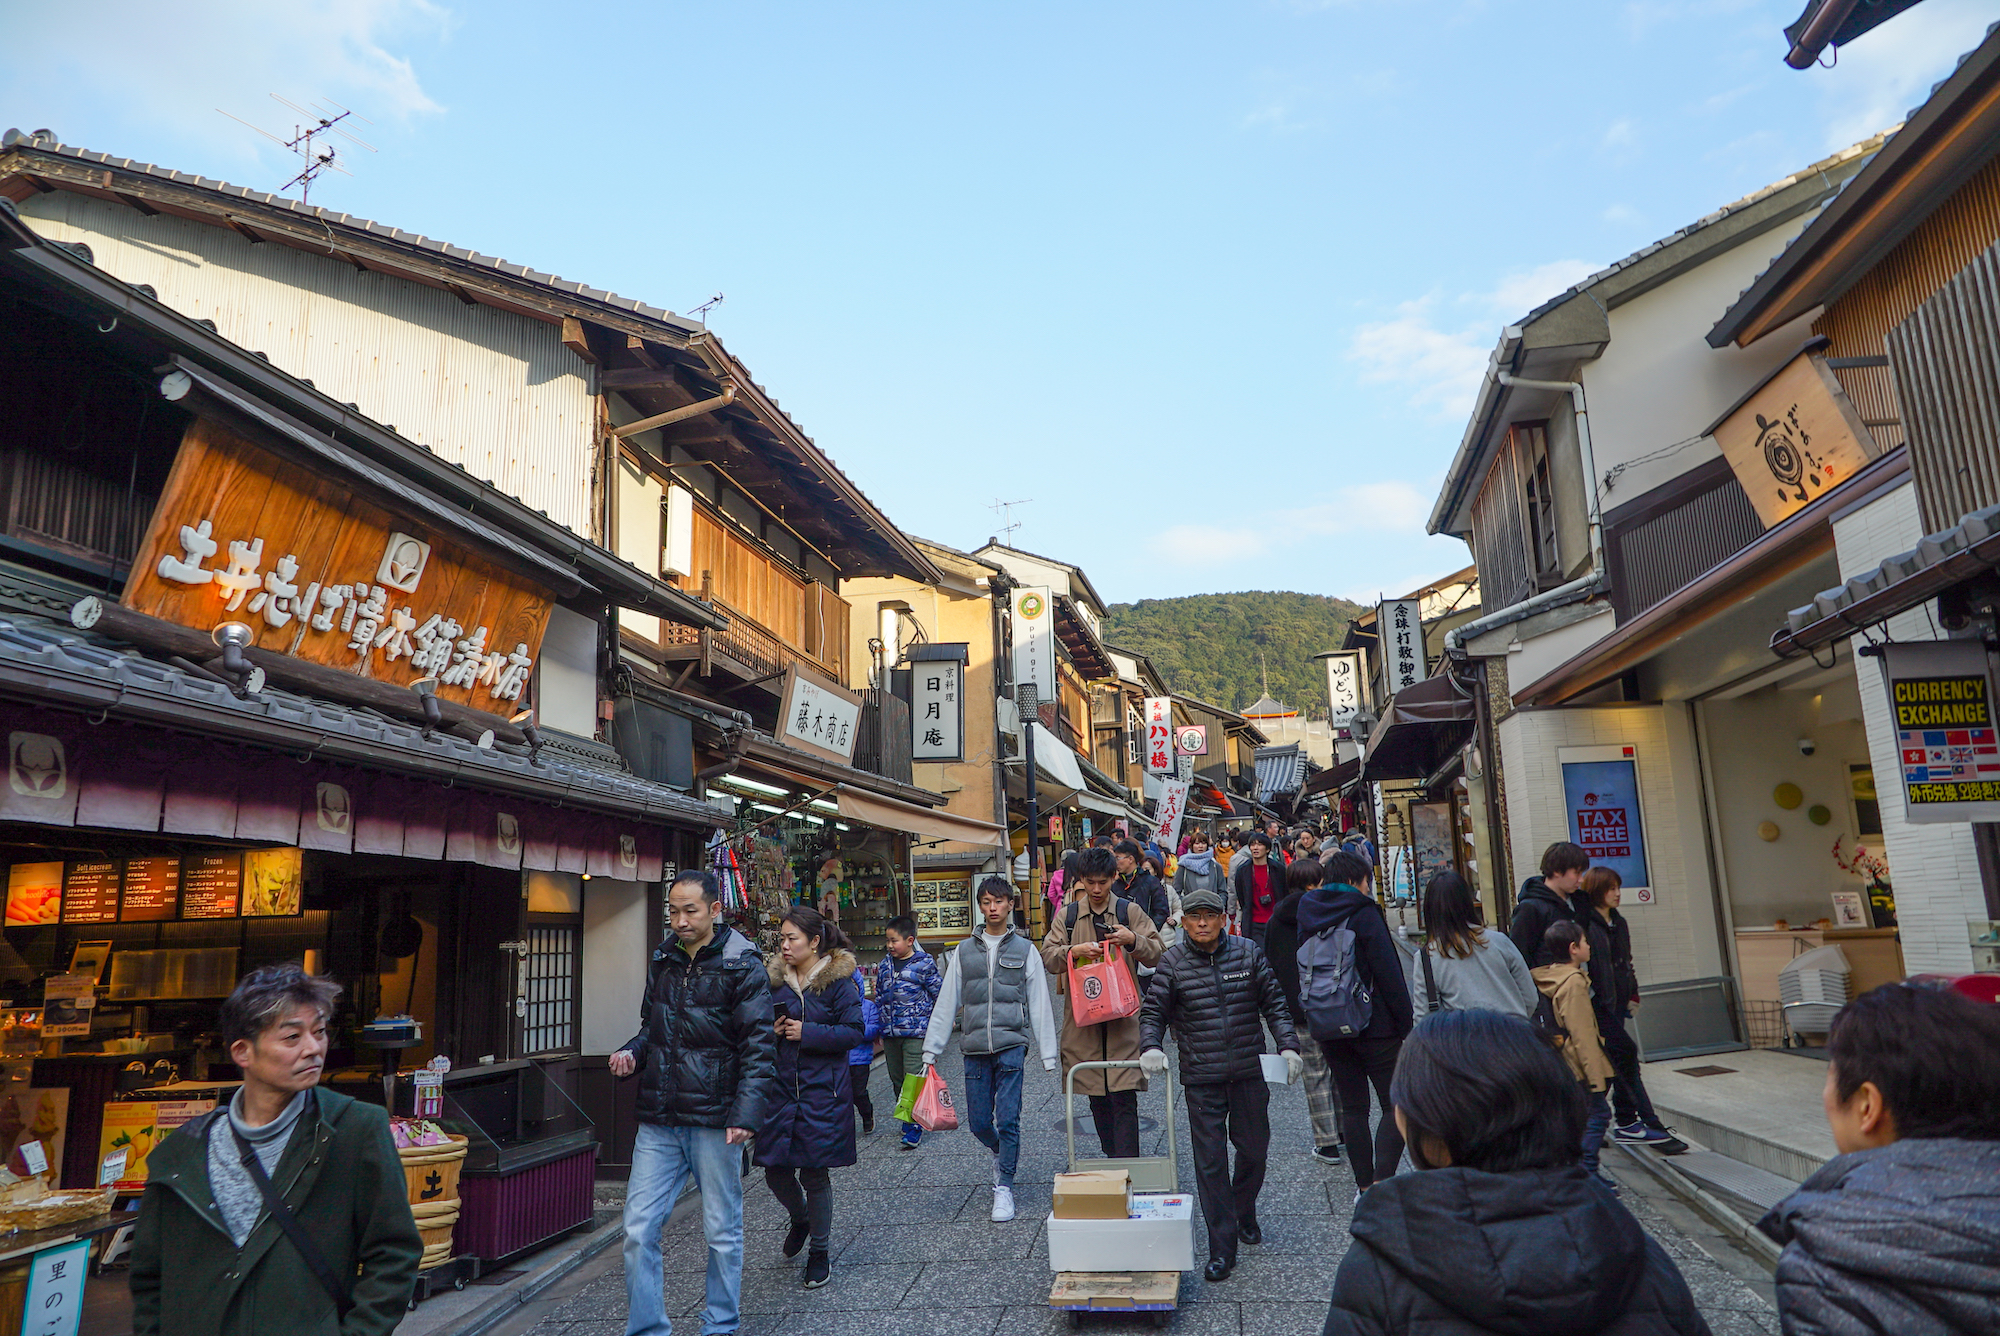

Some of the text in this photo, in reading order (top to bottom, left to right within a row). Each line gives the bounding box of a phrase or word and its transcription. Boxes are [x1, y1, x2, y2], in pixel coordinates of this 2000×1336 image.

[945, 667, 955, 702] 京料理
[1333, 661, 1355, 716] ゆどうふ
[1895, 679, 1985, 703] CURRENCY
[795, 700, 849, 746] 藤木商店
[922, 677, 945, 746] 日月庵
[1898, 703, 1988, 725] EXCHANGE
[1578, 810, 1625, 827] TAX
[1580, 826, 1628, 843] FREE
[203, 857, 223, 865] Frozen
[420, 1169, 443, 1200] 土
